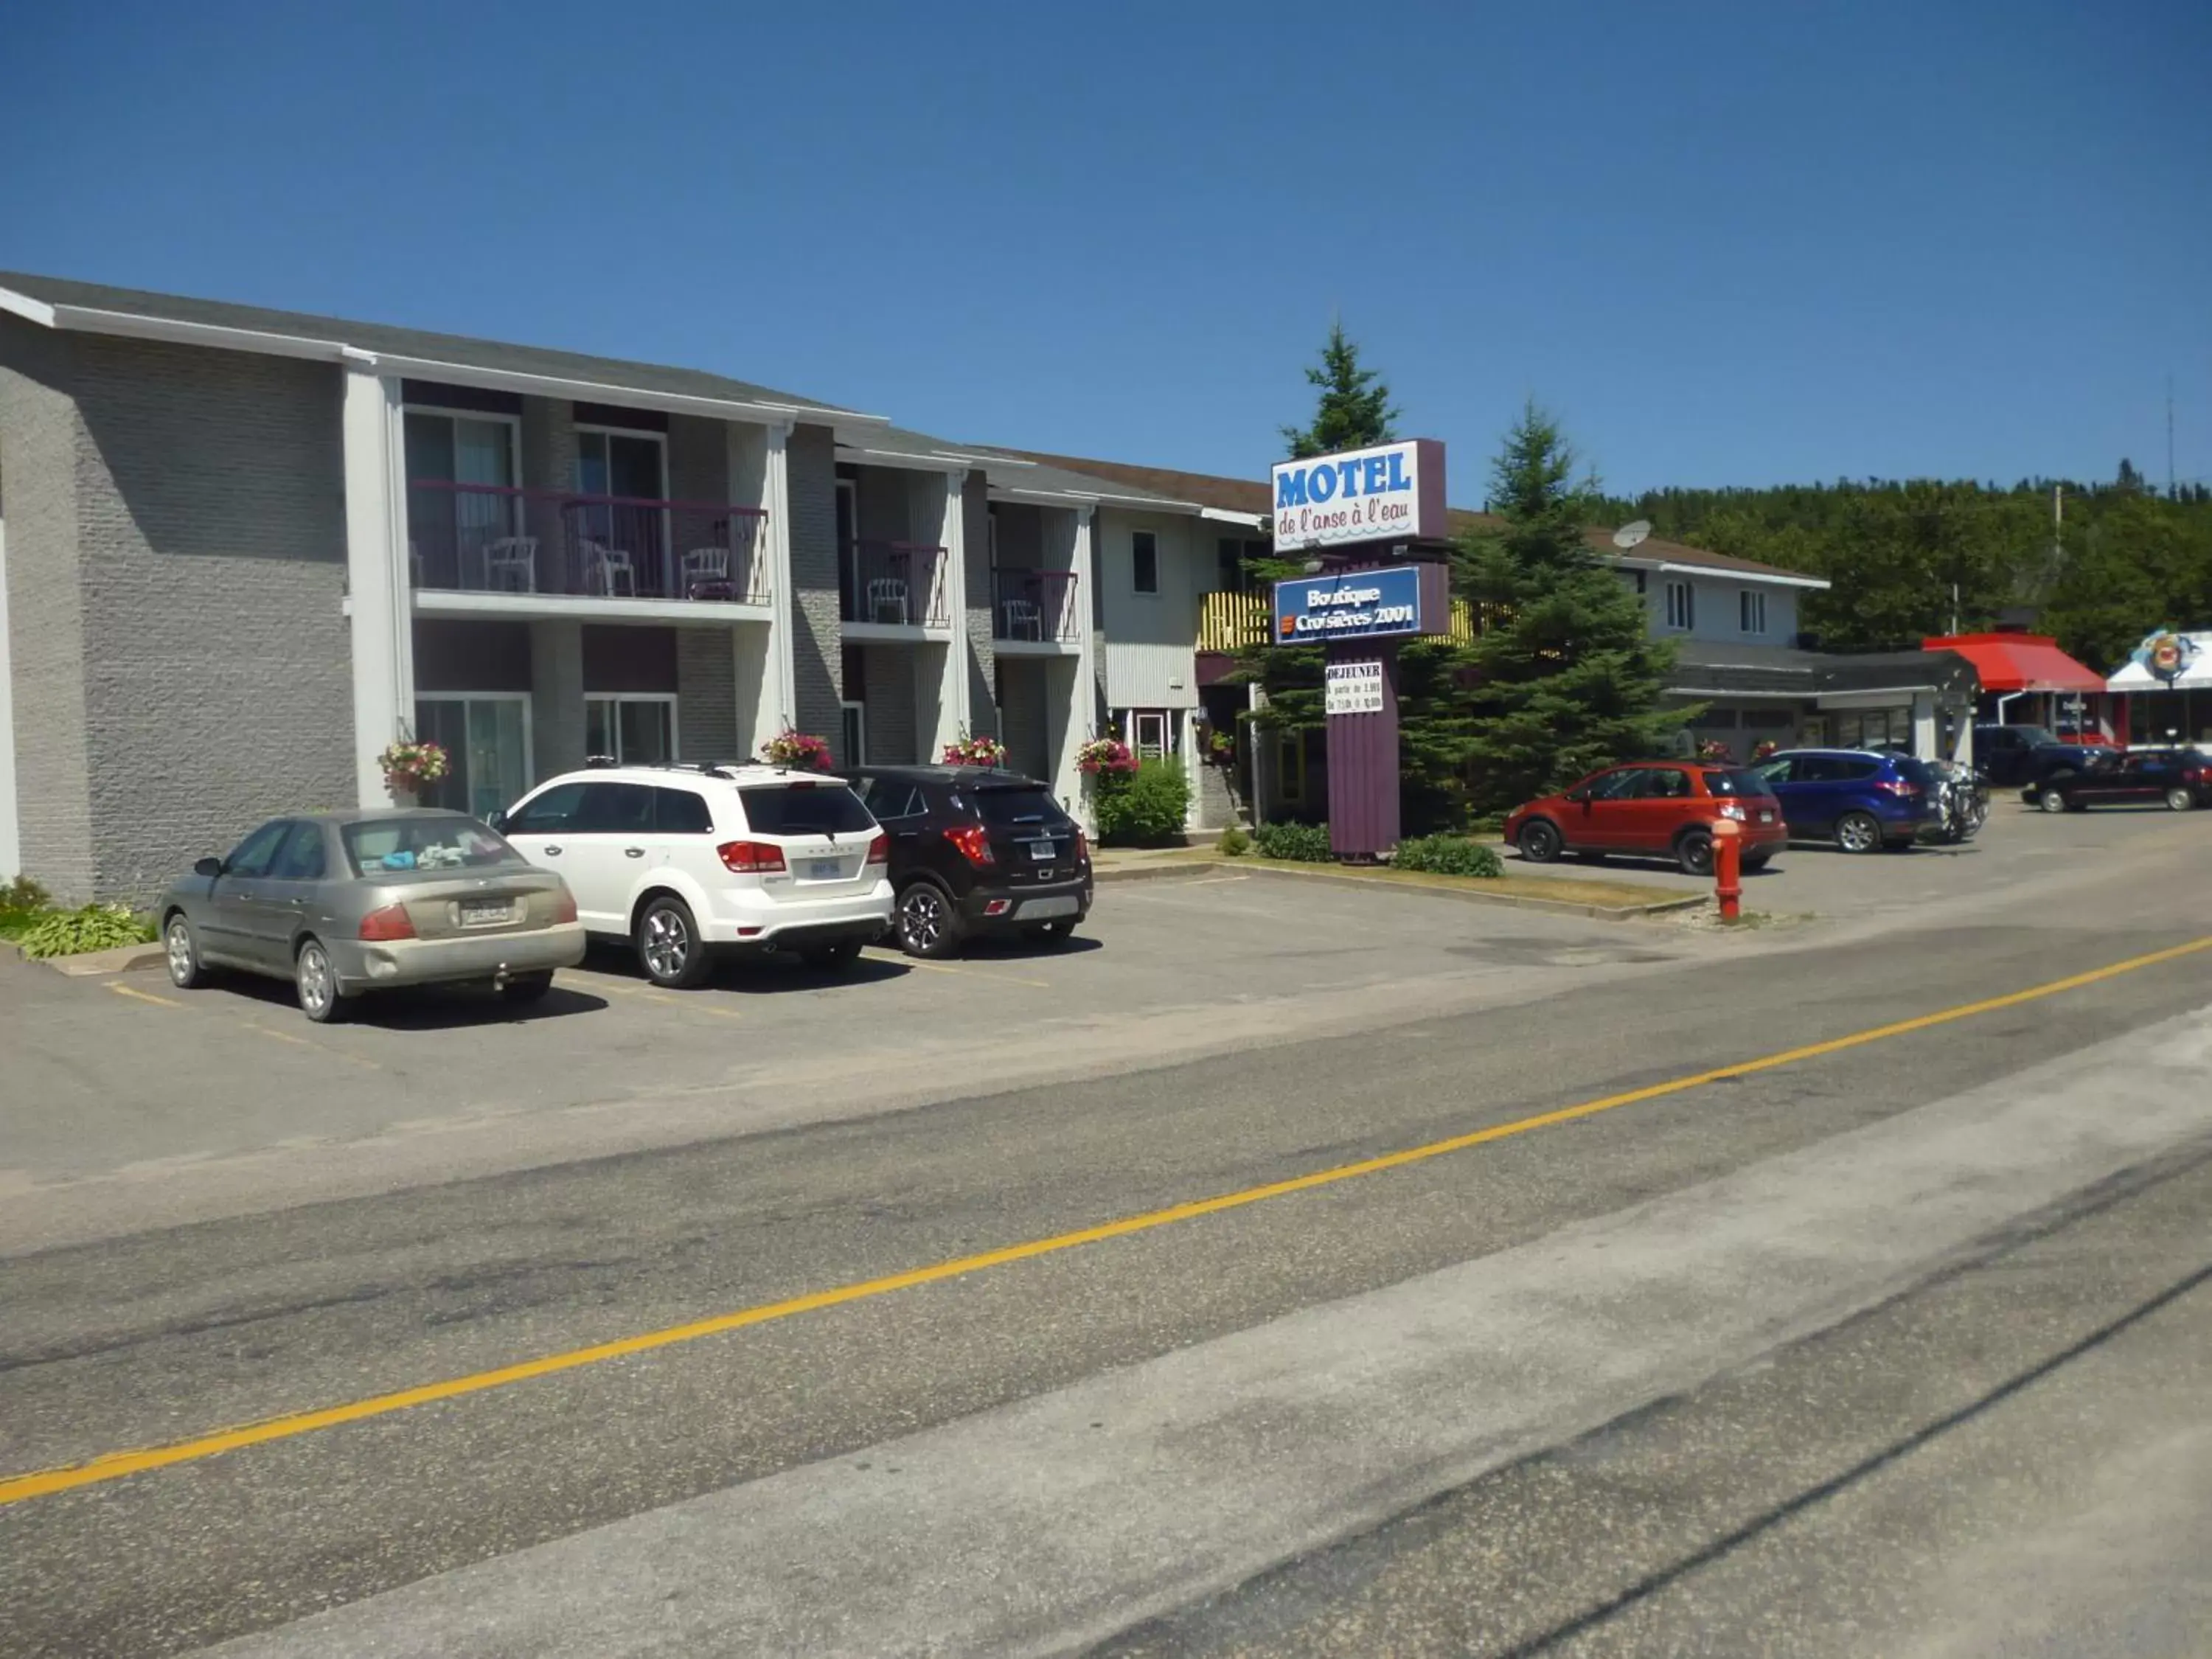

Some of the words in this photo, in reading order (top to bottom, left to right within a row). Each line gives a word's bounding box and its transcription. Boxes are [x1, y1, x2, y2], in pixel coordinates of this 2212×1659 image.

[1277, 452, 1411, 509] MOTEL
[1279, 511, 1295, 535] de
[1301, 507, 1346, 532] l'anse
[1352, 503, 1362, 525] à
[1368, 498, 1408, 523] l'eau
[1307, 585, 1380, 608] Boutique
[1296, 610, 1372, 631] Croisières
[1374, 605, 1413, 624] 2001
